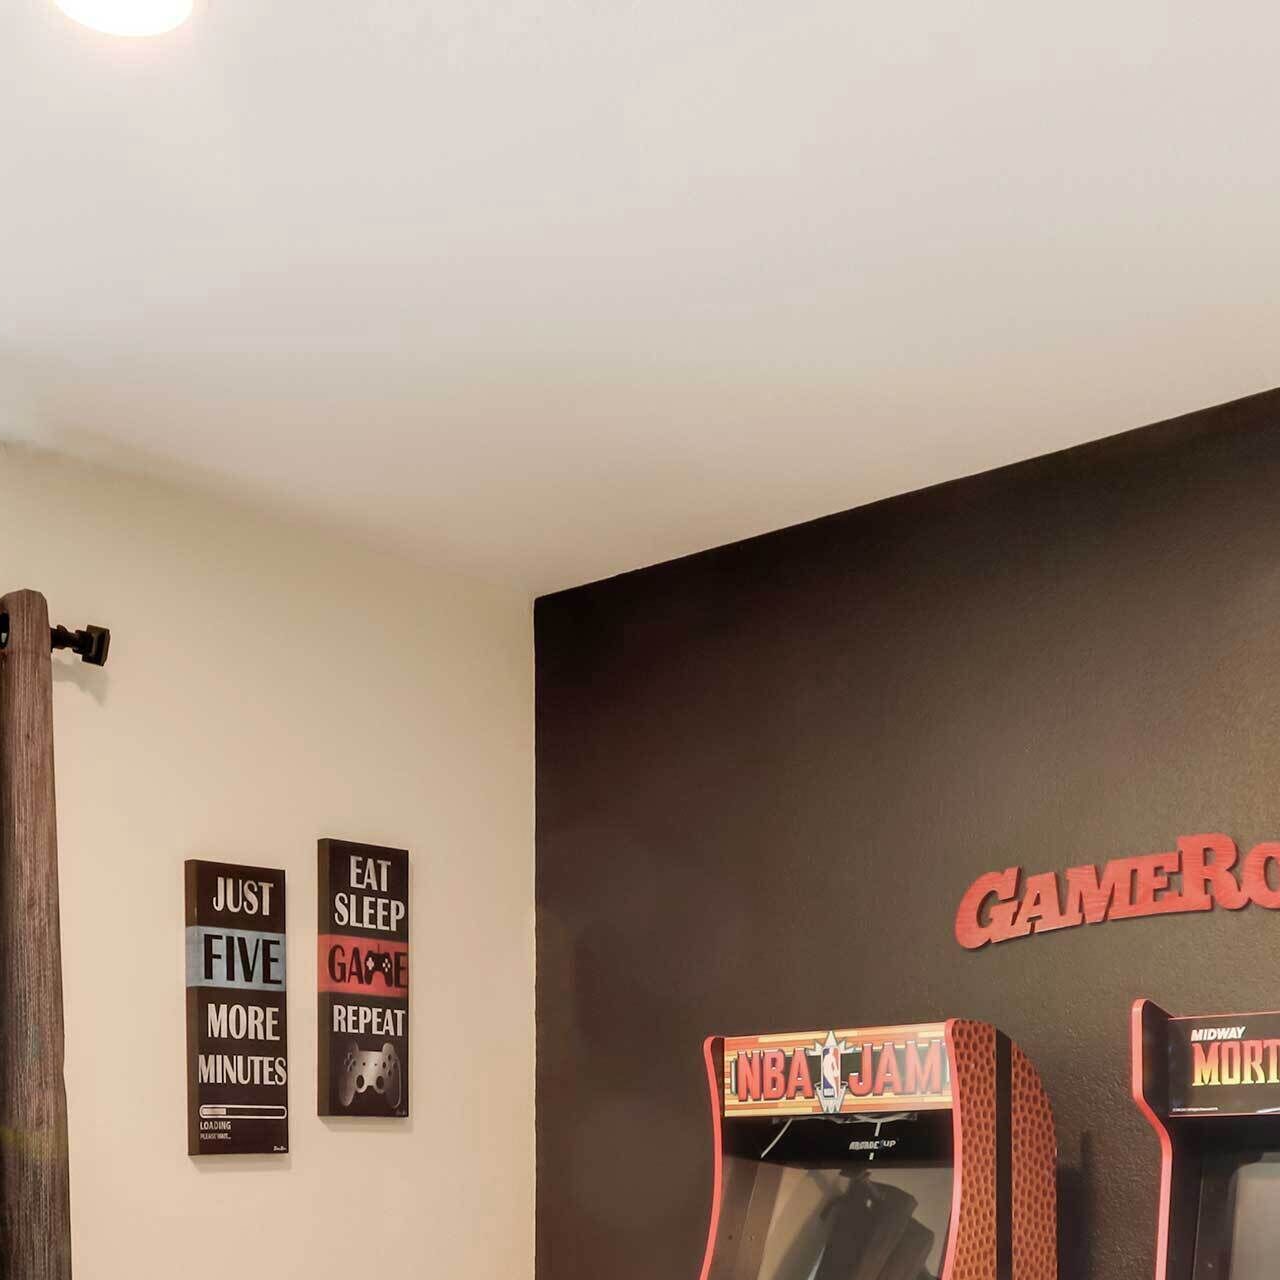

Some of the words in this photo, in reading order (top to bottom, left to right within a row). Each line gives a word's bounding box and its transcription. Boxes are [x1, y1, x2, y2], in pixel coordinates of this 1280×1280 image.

[349, 855, 391, 892] EAT
[213, 877, 274, 916] JUST
[334, 892, 405, 932] SLEEP
[203, 933, 282, 985] FIVE
[207, 1003, 280, 1041] MORE
[333, 1004, 405, 1037] REPEAT
[1191, 1026, 1246, 1041] MIDWAY
[198, 1055, 287, 1086] MINUTES
[737, 1048, 815, 1102] NBA
[848, 1040, 943, 1097] JAM
[200, 1121, 232, 1130] LOADING
